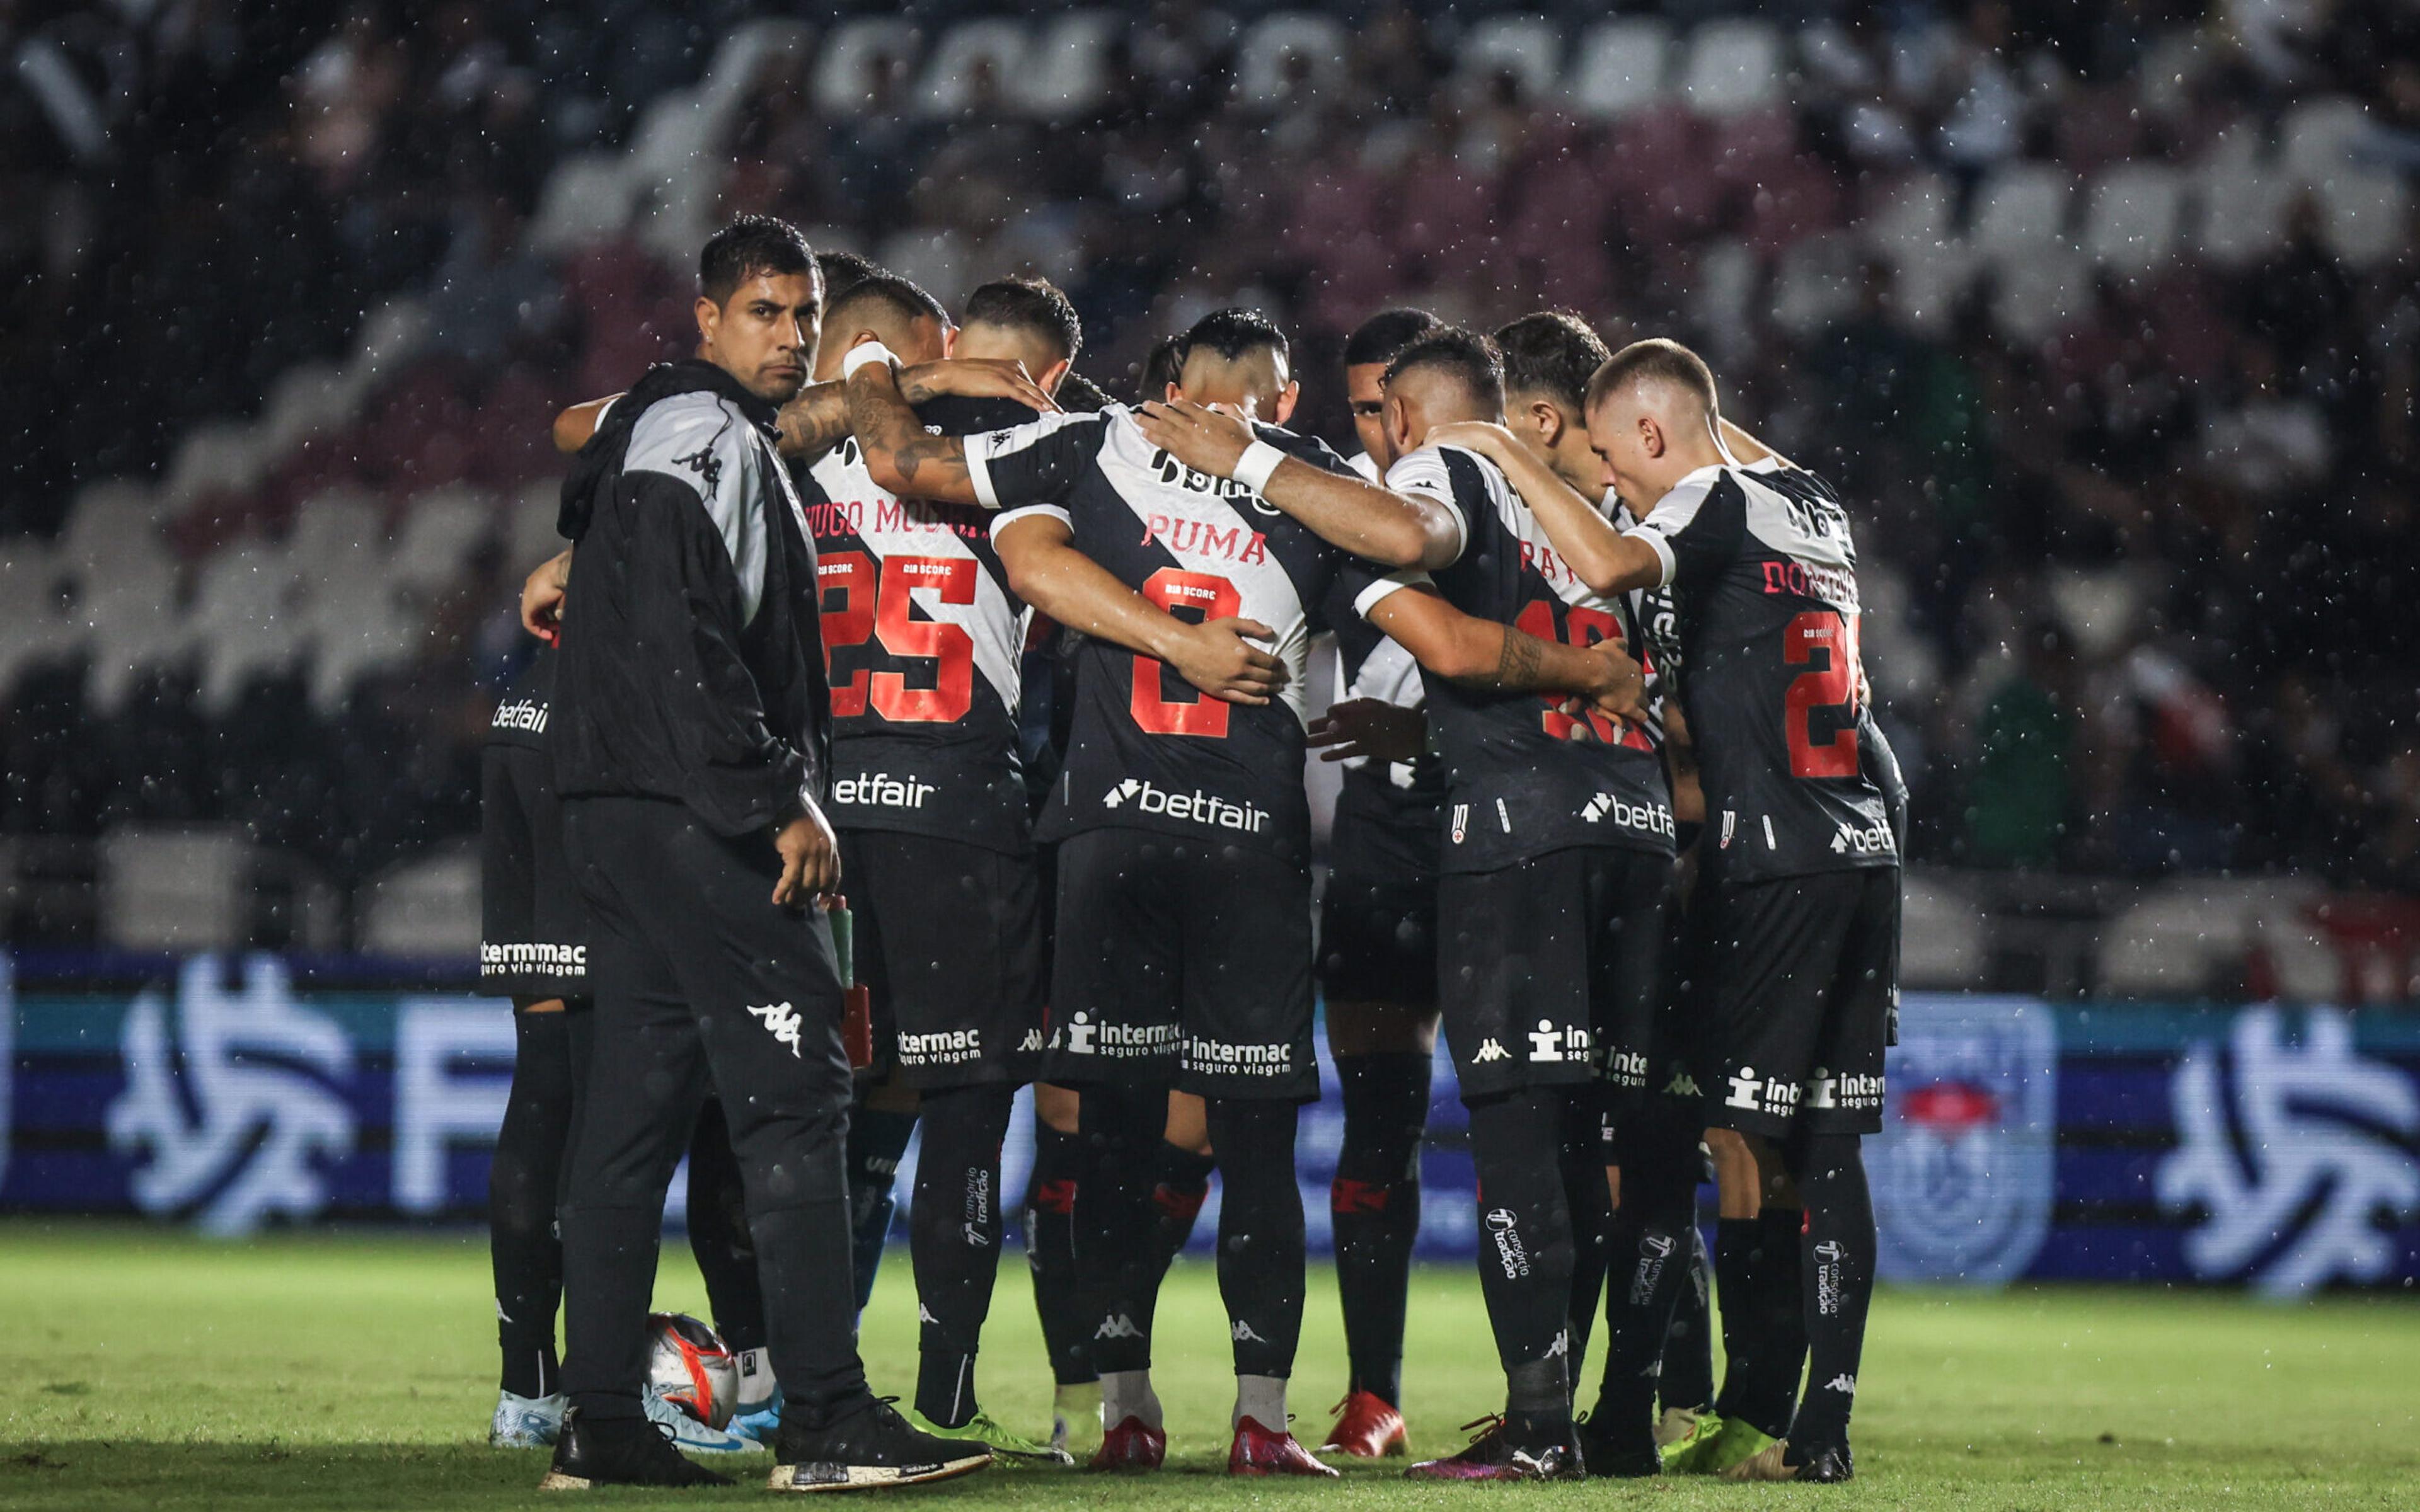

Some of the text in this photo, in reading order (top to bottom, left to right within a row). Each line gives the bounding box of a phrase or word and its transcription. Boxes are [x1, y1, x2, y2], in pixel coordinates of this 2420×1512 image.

[874, 500, 989, 539] MOU
[1141, 513, 1267, 566] PUMA
[828, 564, 853, 574] SCORE
[919, 564, 952, 576] SCORE
[1184, 585, 1216, 600] SCORE
[818, 551, 978, 723] 25
[832, 772, 935, 808] etfair
[1139, 781, 1270, 832] betfair
[930, 1049, 981, 1064] viagem
[1100, 1046, 1149, 1058] seguro
[1192, 1035, 1291, 1063] intermac
[1192, 1061, 1291, 1076] seguro viagem
[1766, 1070, 1802, 1104] int
[976, 1170, 989, 1224] tradição
[1507, 1229, 1530, 1276] consórcio
[1818, 1264, 1831, 1315] tradição
[1830, 1263, 1840, 1314] consórcio
